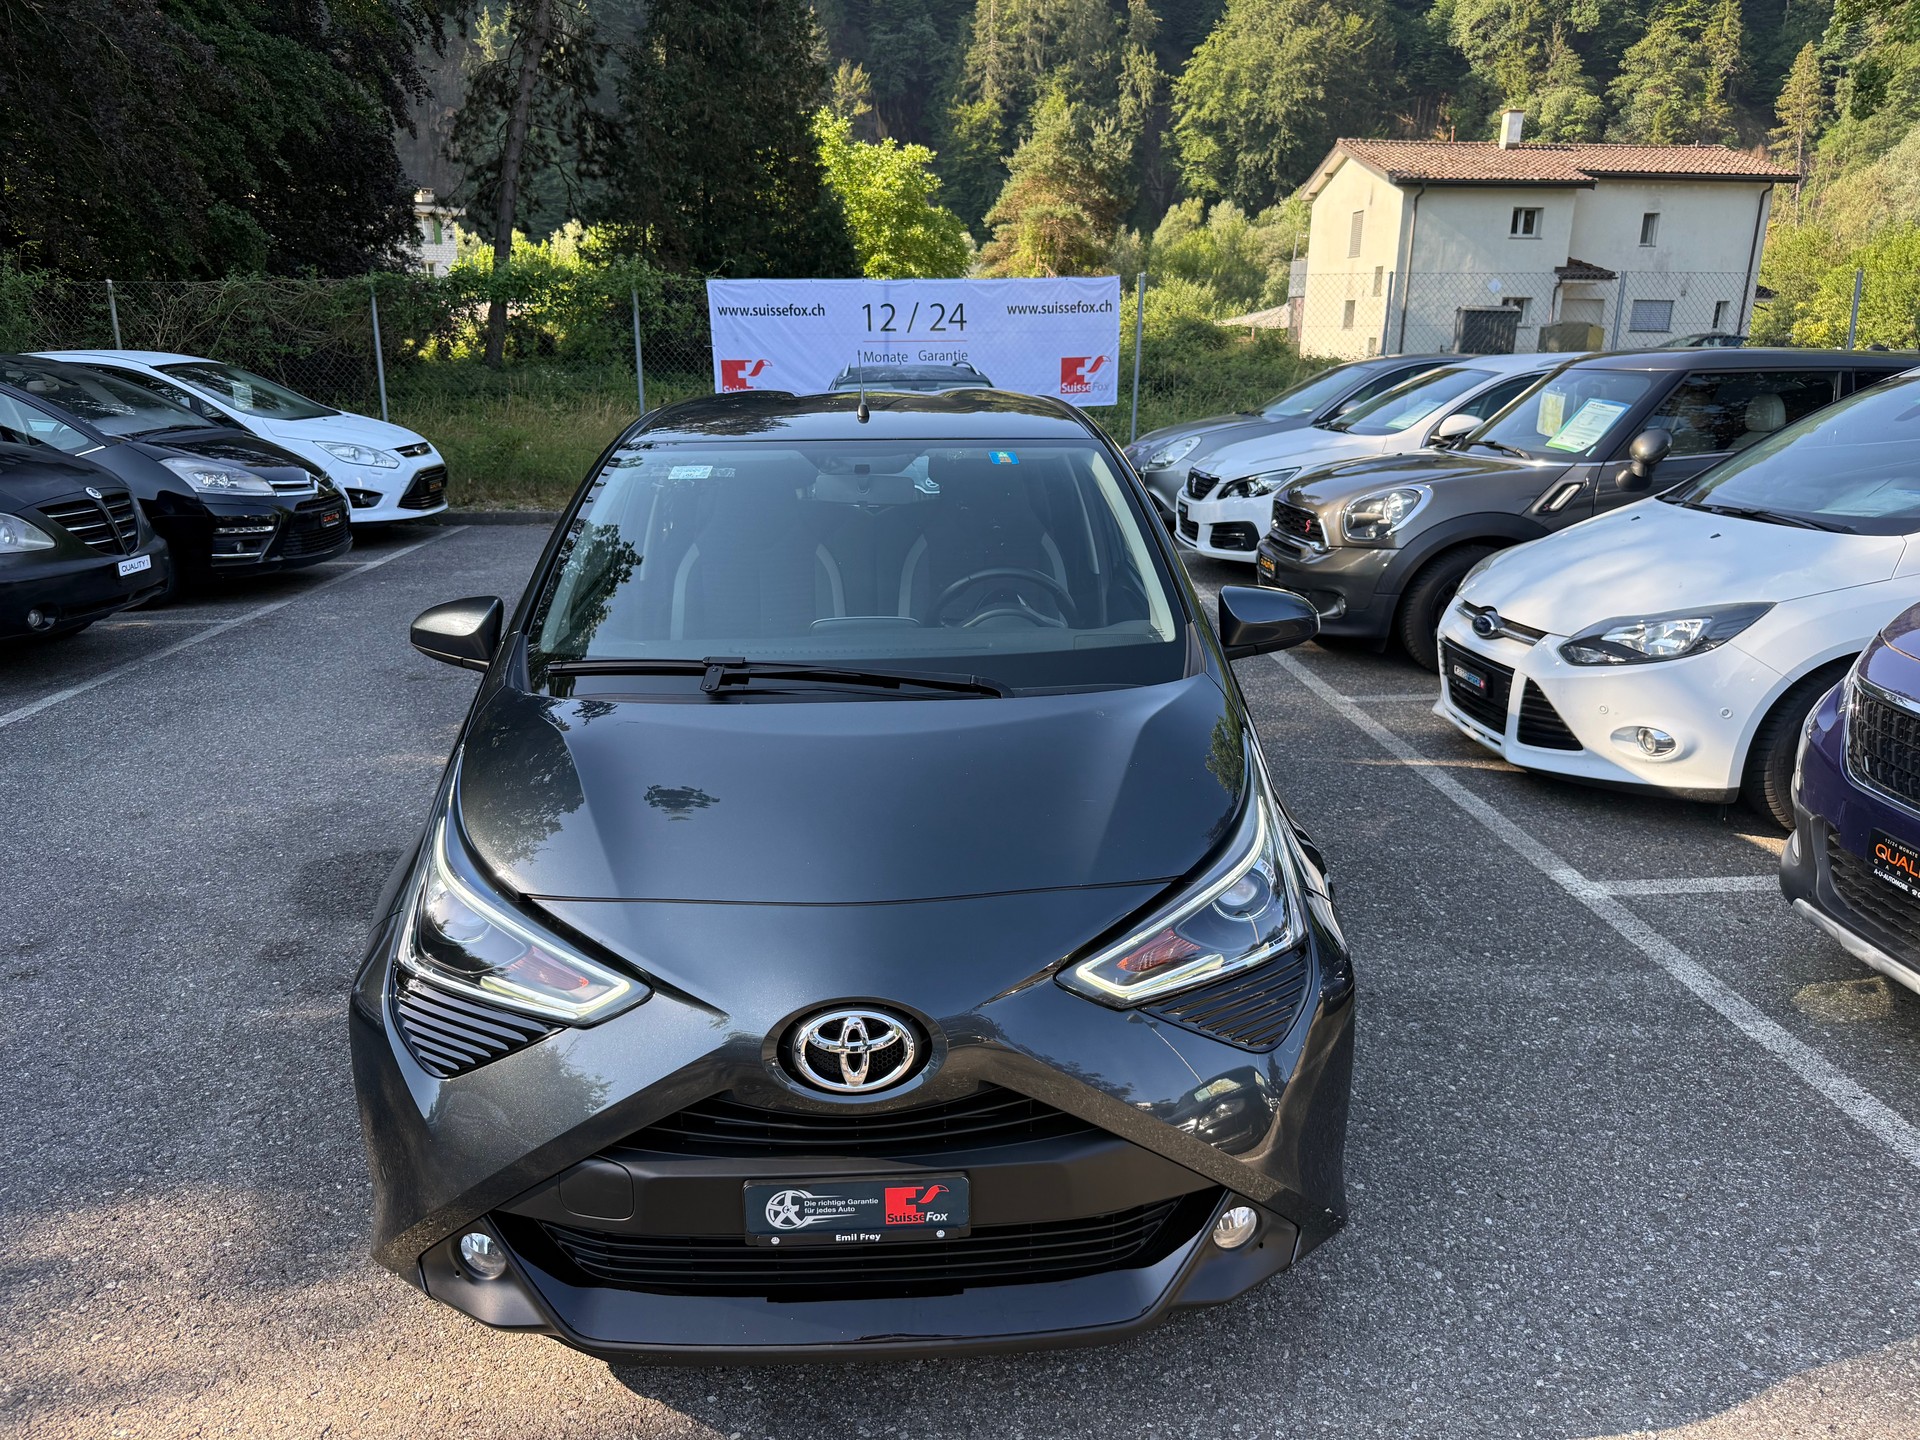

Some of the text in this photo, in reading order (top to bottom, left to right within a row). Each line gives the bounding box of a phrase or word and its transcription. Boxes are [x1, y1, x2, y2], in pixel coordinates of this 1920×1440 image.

[717, 303, 826, 317] www.suissefox.ch
[1006, 299, 1113, 315] www.suissefox.ch
[862, 302, 967, 333] 12 / 24
[863, 349, 969, 363] Monate Garantie
[122, 560, 146, 572] QUALITY
[1898, 845, 1919, 859] MONATE
[818, 1199, 846, 1208] richtige
[847, 1197, 879, 1205] Garantie
[816, 1206, 837, 1215] jedes
[835, 1233, 882, 1242] Emil Frey
